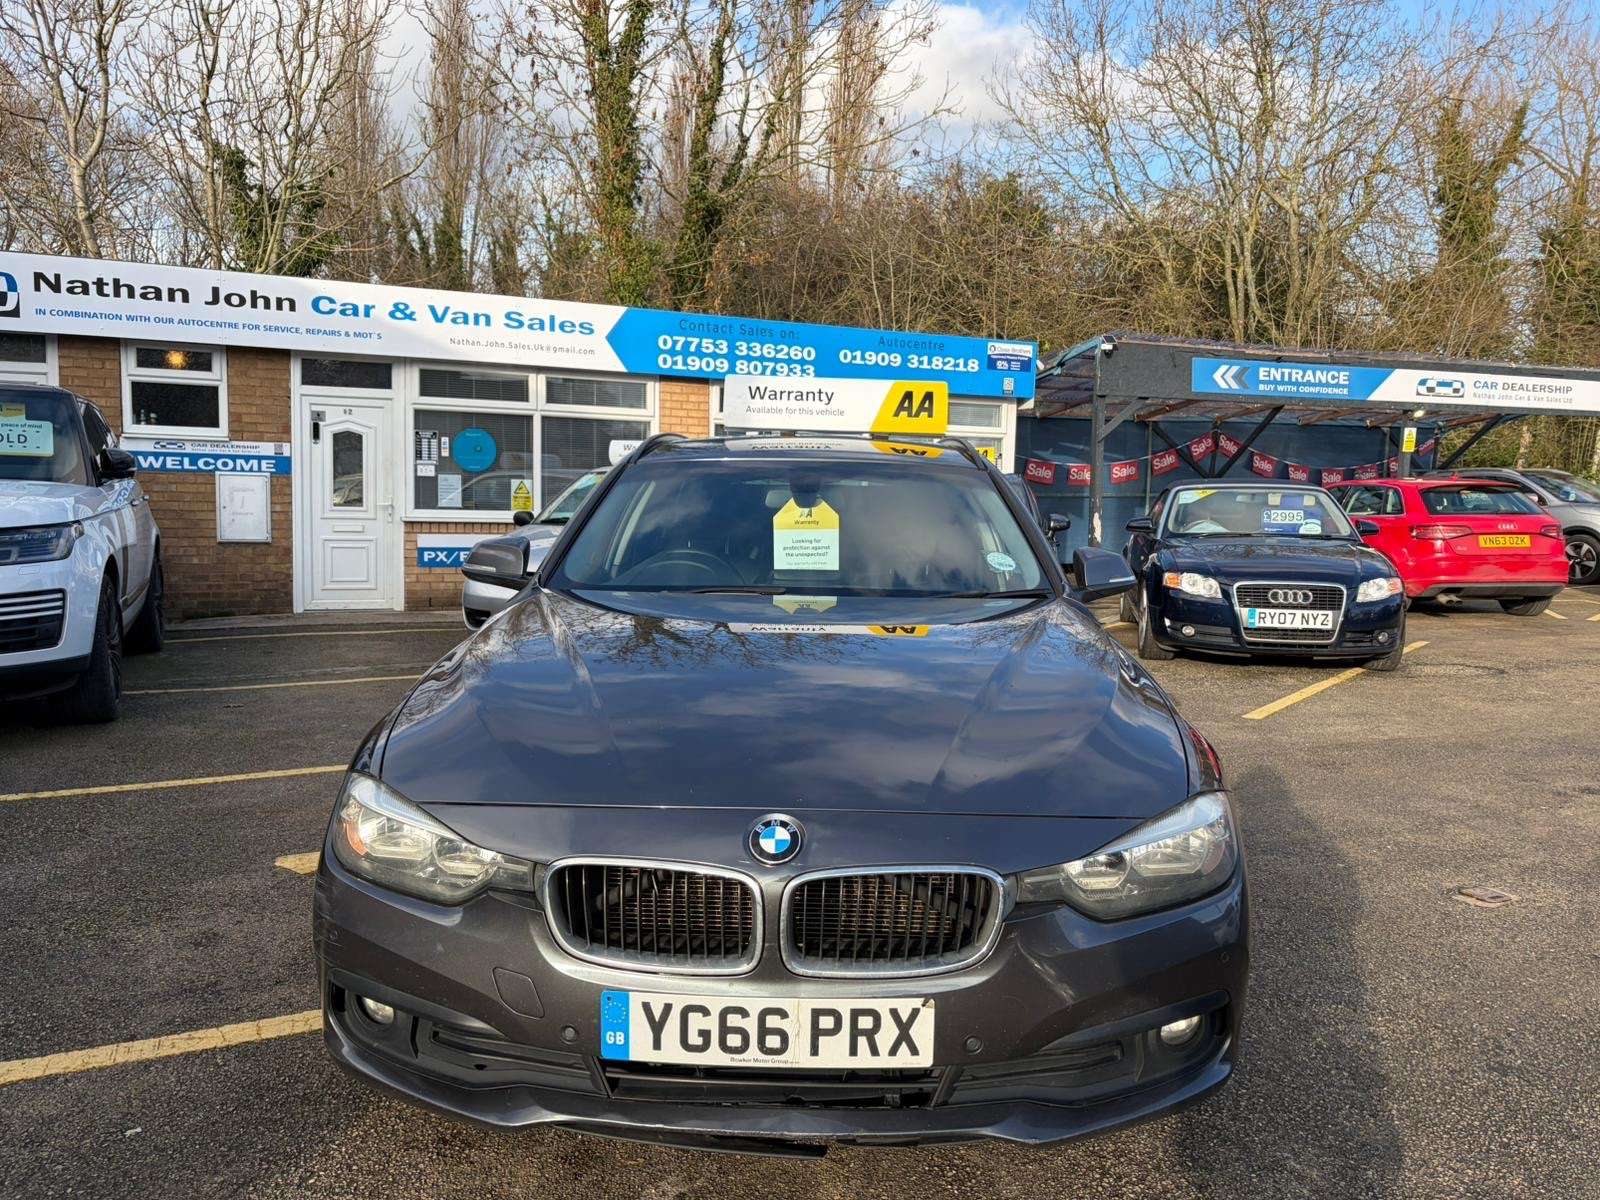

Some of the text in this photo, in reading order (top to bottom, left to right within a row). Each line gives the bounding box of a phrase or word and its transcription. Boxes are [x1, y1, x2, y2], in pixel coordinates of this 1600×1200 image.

[33, 271, 595, 336] Nathan John Car & Van Sales
[35, 308, 46, 316] IN
[50, 308, 122, 321] COMBINATION
[126, 314, 150, 323] WITH
[154, 316, 175, 325] OUR
[178, 318, 240, 330] AUTOCENTRE
[242, 323, 260, 332] FOR
[263, 324, 303, 336] SERVICE,
[306, 328, 342, 338] REPAIRS
[679, 319, 800, 340] Contact Sales on:
[657, 335, 816, 361] 07753 336260
[878, 336, 945, 351] Autocentre
[657, 354, 816, 377] 01909 807933
[839, 350, 980, 373] 01909 318218
[1258, 367, 1350, 384] ENTRANCE
[1259, 383, 1348, 395] BUY WITH CONFIDENCE
[1474, 380, 1573, 394] CAR DEALERSHIP
[748, 385, 834, 406] Warranty
[746, 404, 845, 417] Available for this vehicle
[893, 390, 934, 418] AA
[1192, 438, 1212, 456] Sale
[1220, 434, 1238, 454] Sale
[138, 455, 276, 472] WELCOME
[1154, 454, 1176, 470] Sale
[1253, 456, 1273, 473] Sale
[1028, 464, 1052, 479] Sale
[1070, 468, 1090, 480] Sale
[1112, 466, 1136, 479] Sale
[1289, 467, 1307, 482] Sale
[1322, 472, 1342, 484] Sale
[1264, 510, 1303, 522] £2995
[1258, 612, 1297, 625] RY07
[1301, 612, 1330, 626] NYZ
[756, 818, 796, 834] BMW
[606, 1031, 624, 1045] GB
[641, 1002, 920, 1058] YG66 PRX
